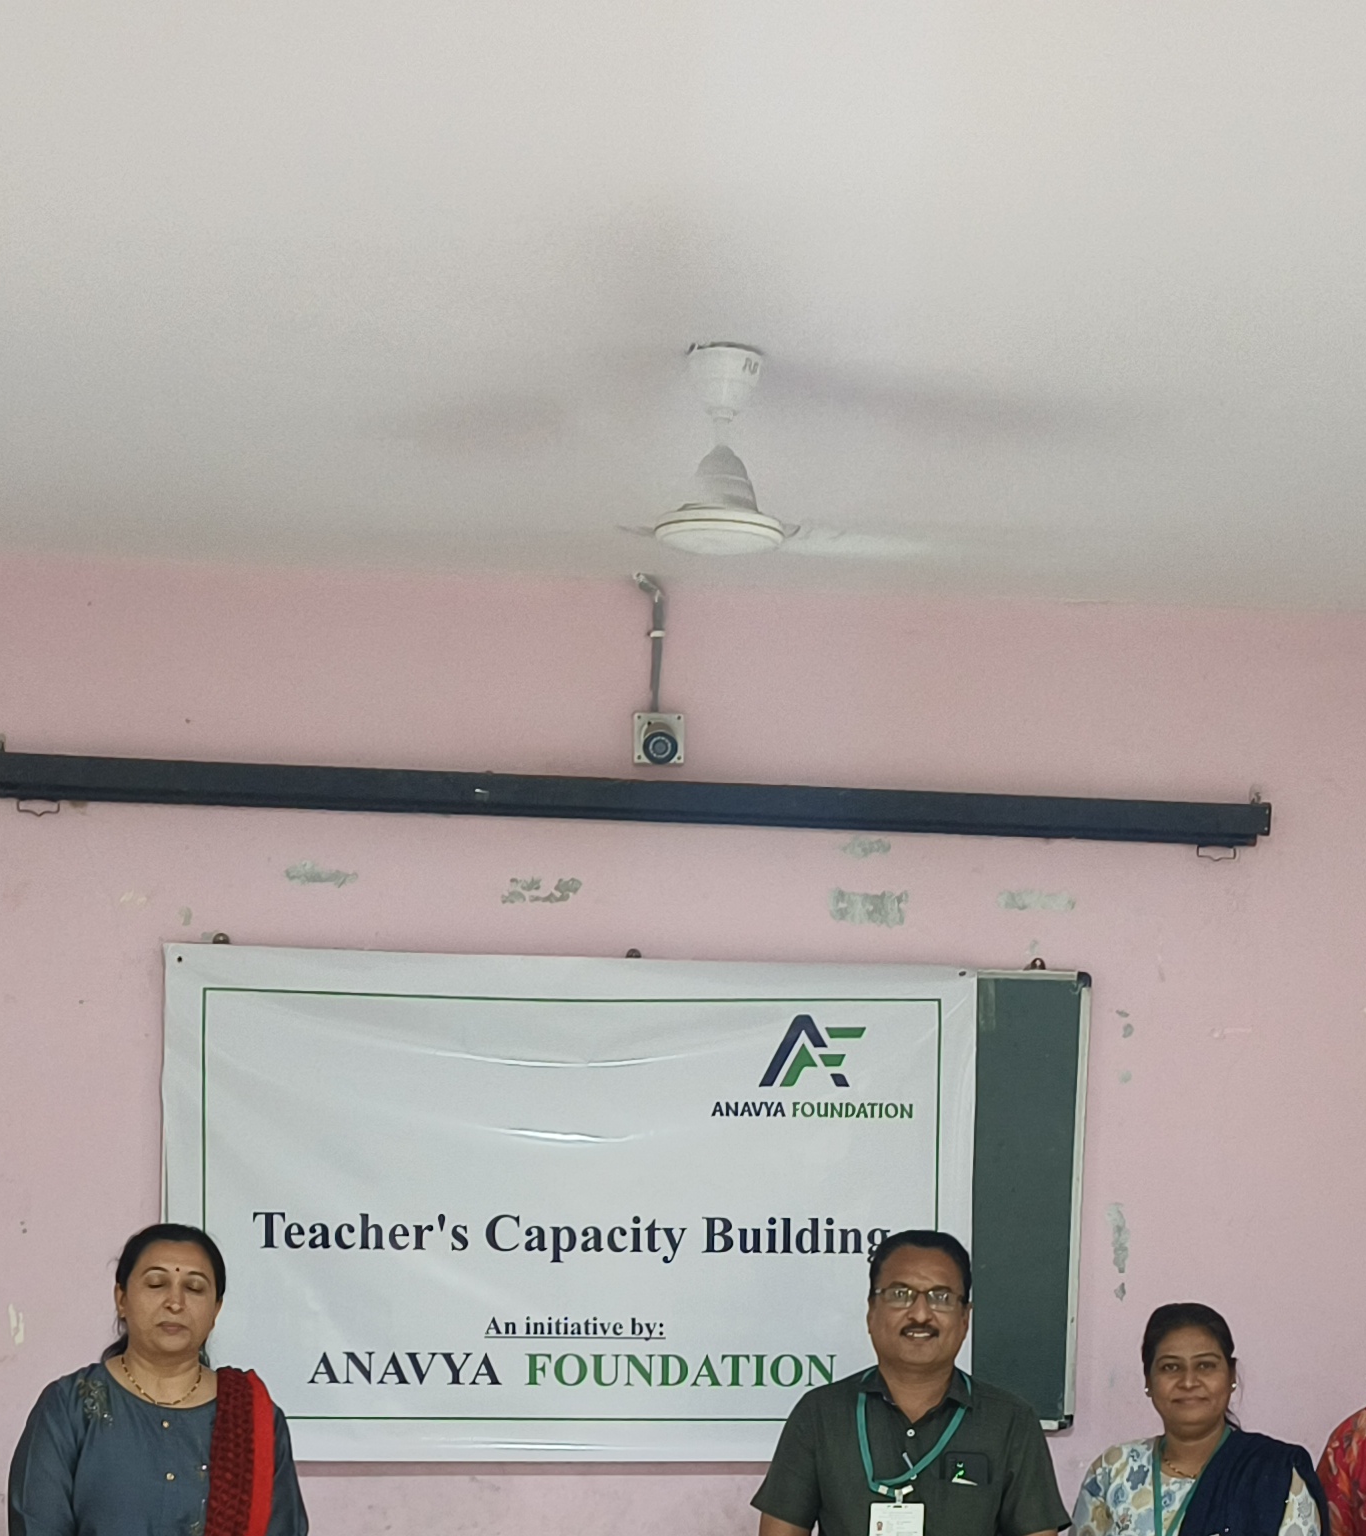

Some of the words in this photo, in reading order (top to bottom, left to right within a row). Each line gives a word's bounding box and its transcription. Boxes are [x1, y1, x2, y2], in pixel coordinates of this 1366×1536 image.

[711, 1101, 786, 1118] ANAVYA
[791, 1102, 914, 1119] FOUNDATION
[252, 1211, 469, 1252] Teacher's
[484, 1213, 687, 1264] Capacity
[484, 1316, 517, 1336] An
[524, 1316, 624, 1336] initiative
[631, 1317, 665, 1341] by:
[307, 1351, 503, 1386] ANAVYA
[524, 1352, 837, 1388] FOUNDATION
